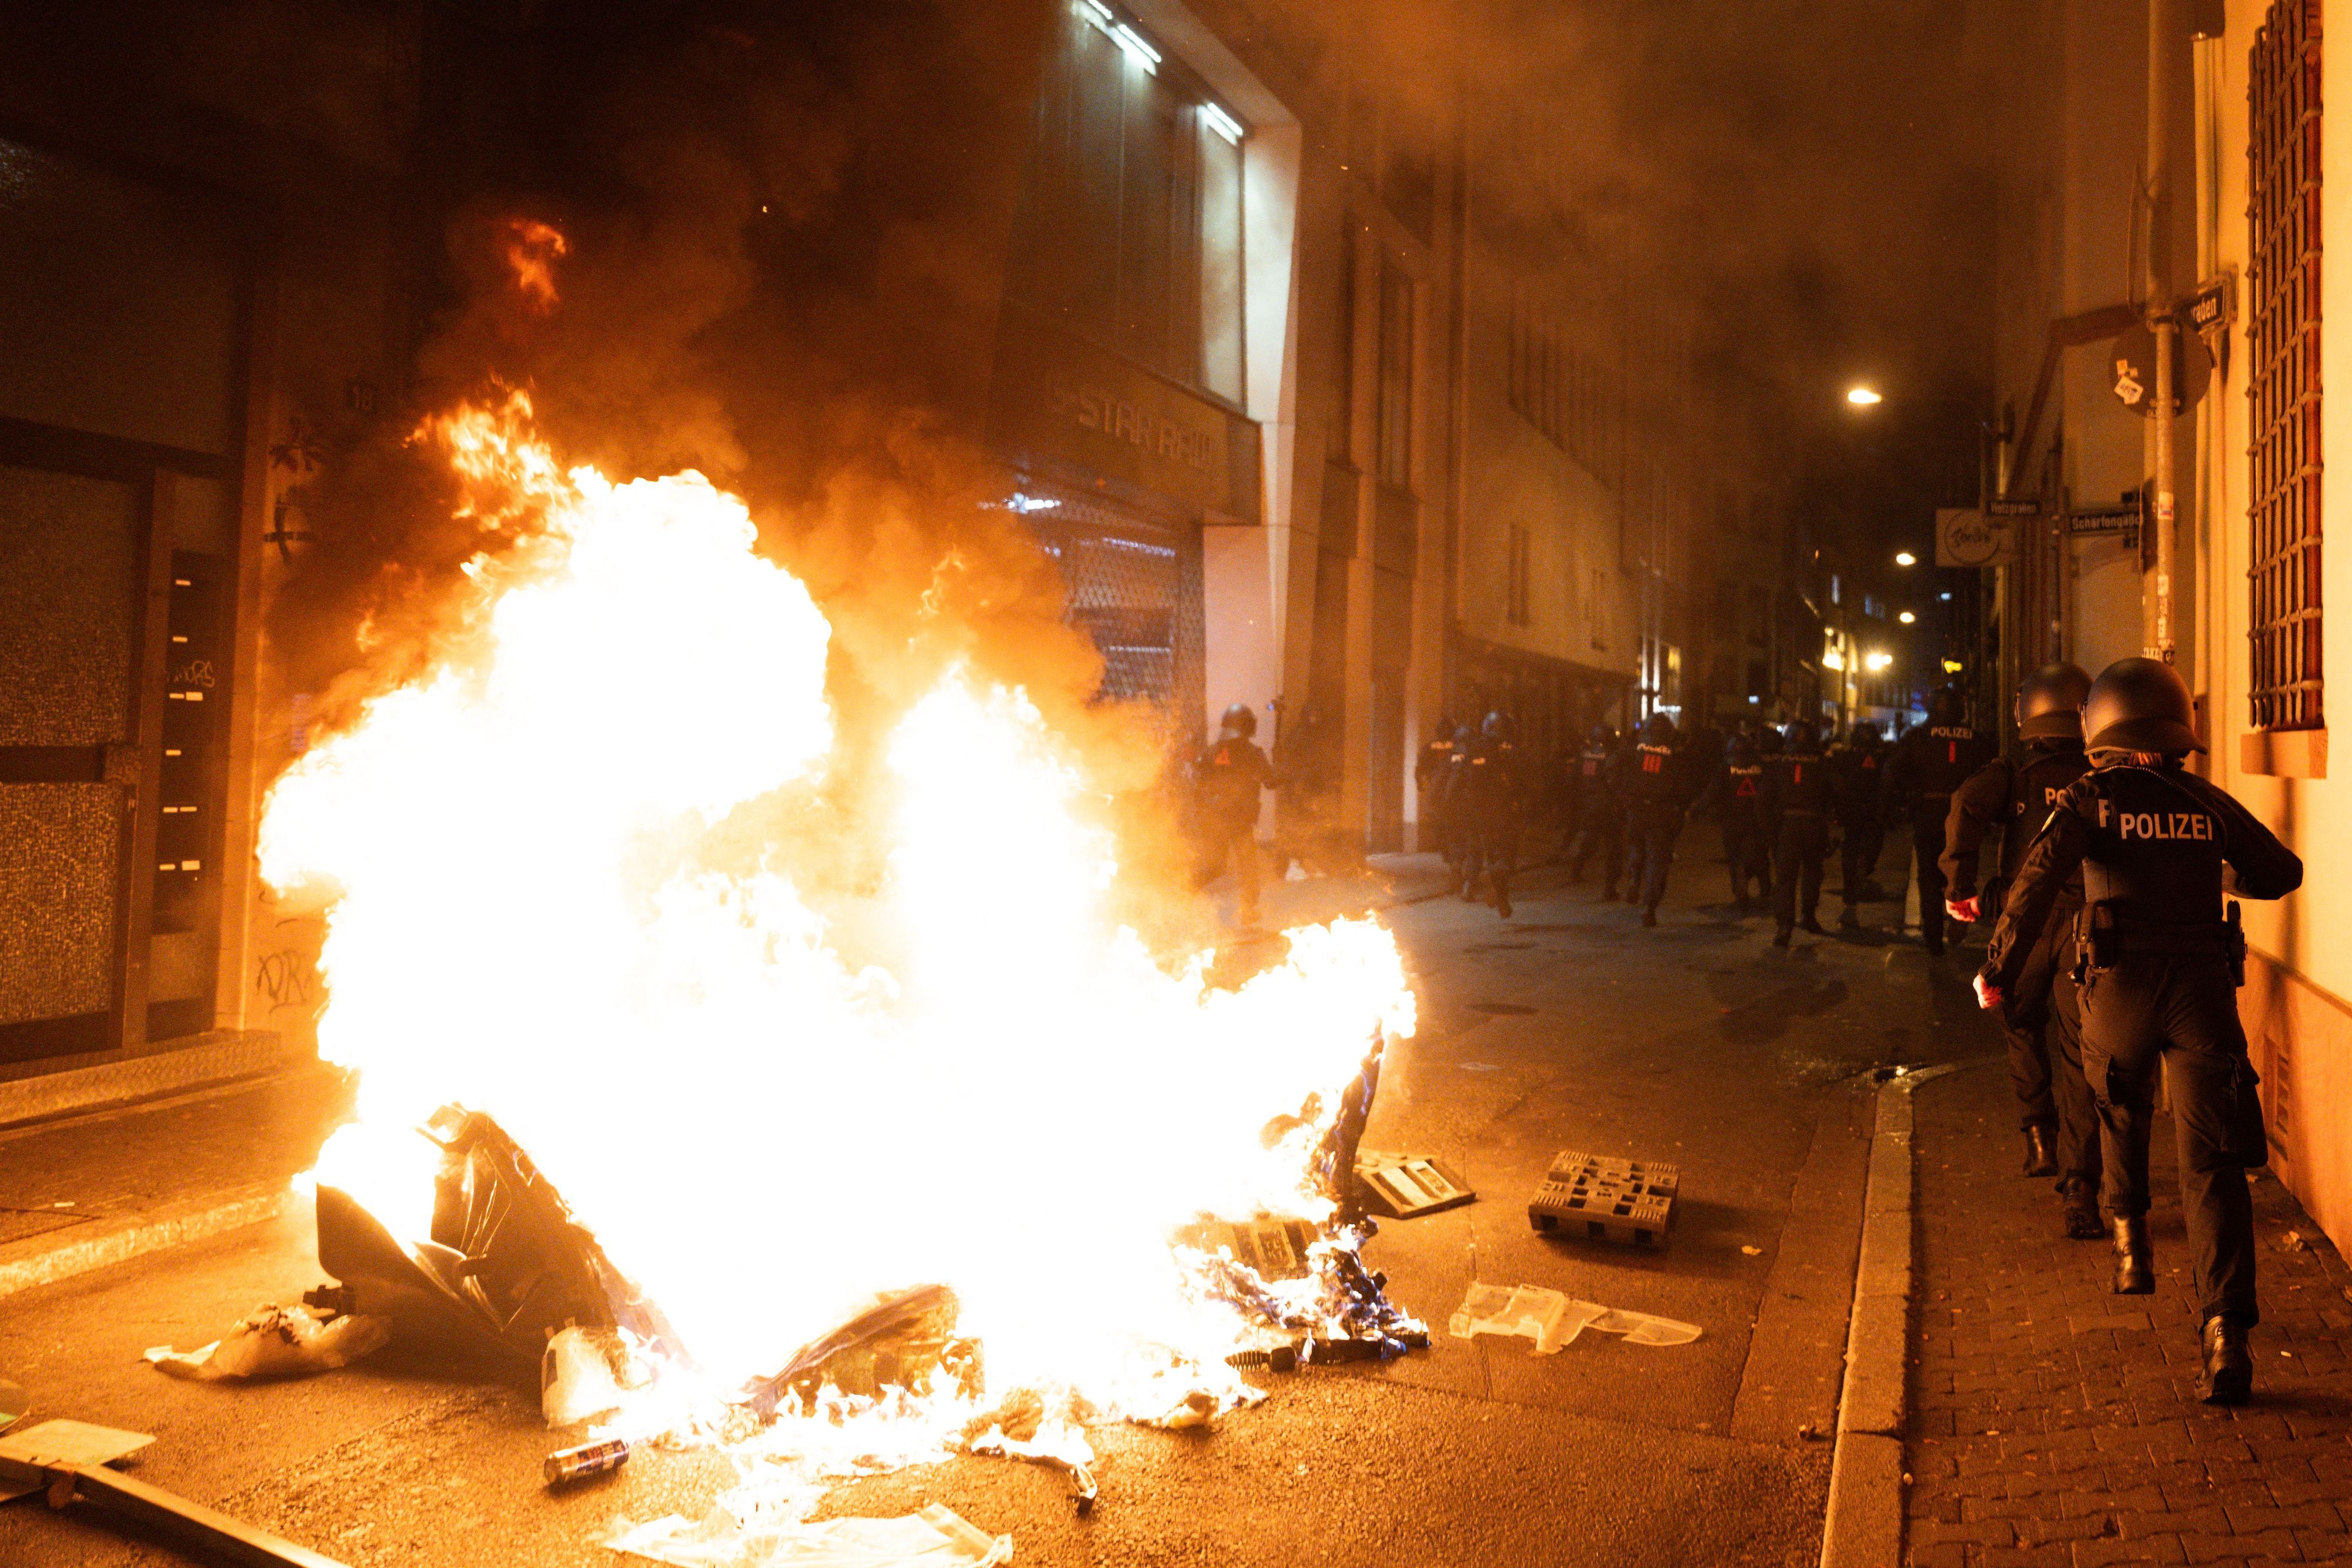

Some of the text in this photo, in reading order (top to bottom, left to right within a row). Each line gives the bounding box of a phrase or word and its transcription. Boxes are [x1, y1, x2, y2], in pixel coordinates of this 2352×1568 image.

[2191, 296, 2217, 324] raben
[1930, 726, 1973, 740] POLIZEI
[2120, 813, 2213, 841] POLIZEI
